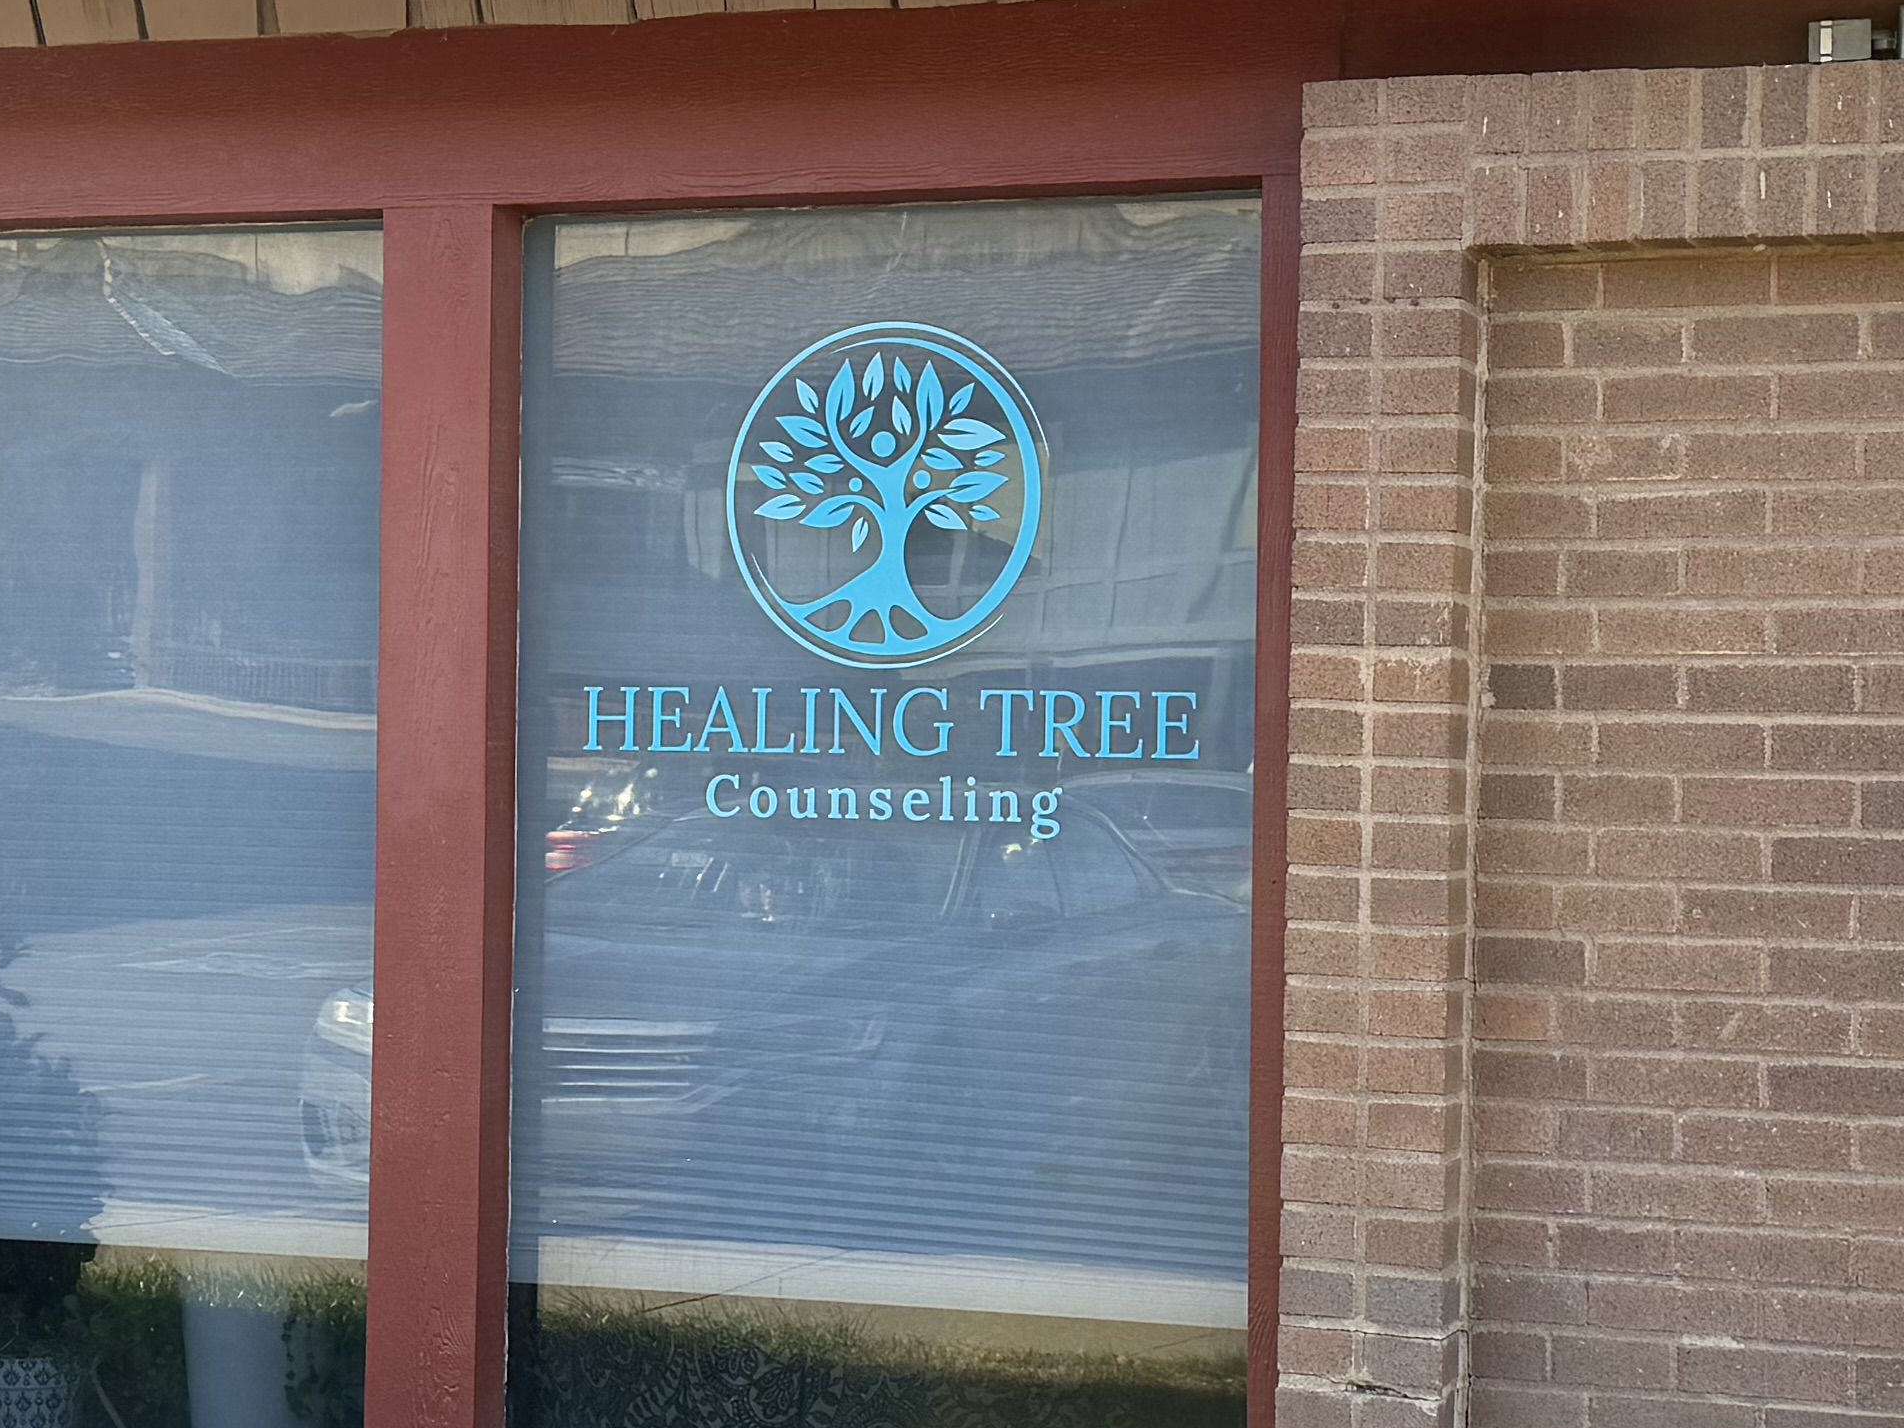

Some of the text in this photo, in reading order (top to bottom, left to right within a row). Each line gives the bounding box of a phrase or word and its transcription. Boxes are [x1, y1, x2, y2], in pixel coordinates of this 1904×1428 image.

[582, 685, 1201, 760] HEALING TREE
[705, 774, 1063, 839] Counseling
